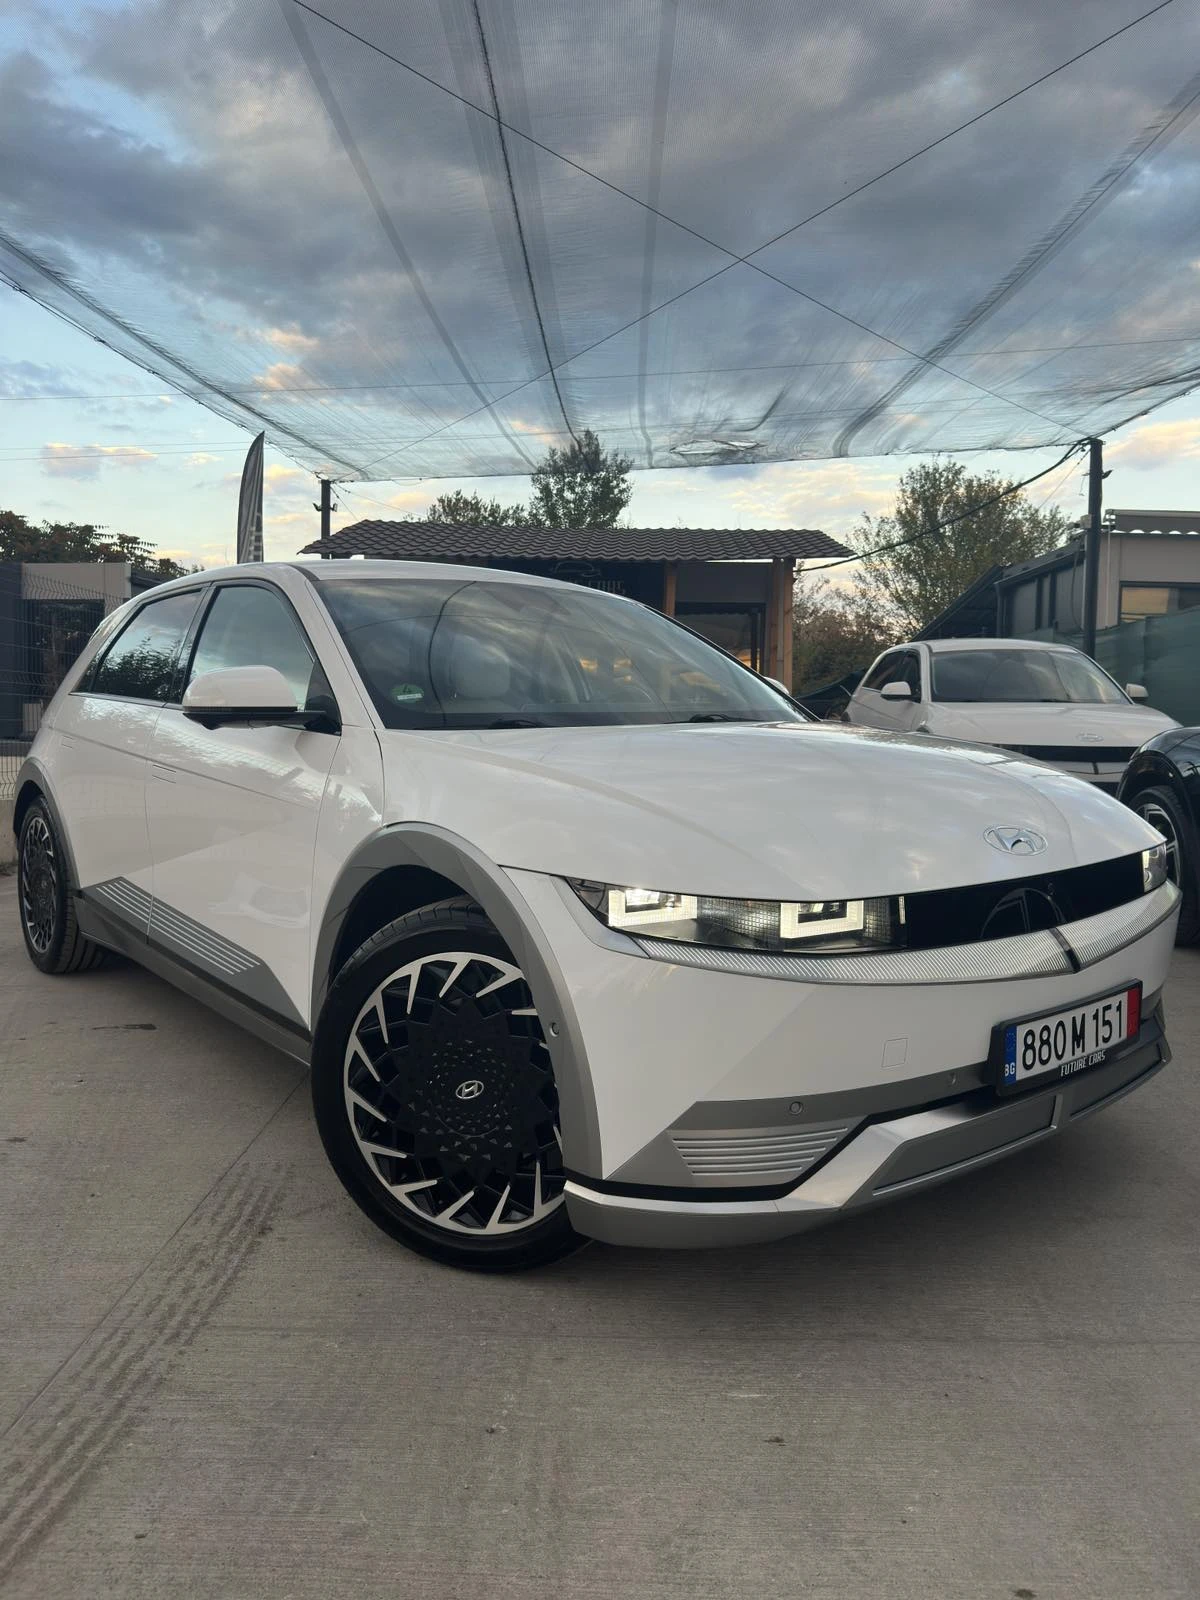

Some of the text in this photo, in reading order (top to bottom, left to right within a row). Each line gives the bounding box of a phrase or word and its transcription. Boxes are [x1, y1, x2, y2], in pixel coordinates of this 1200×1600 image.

[1022, 1000, 1123, 1071] 880 M 151
[1004, 1062, 1016, 1077] BG
[1060, 1050, 1106, 1077] FUTURE CARS
